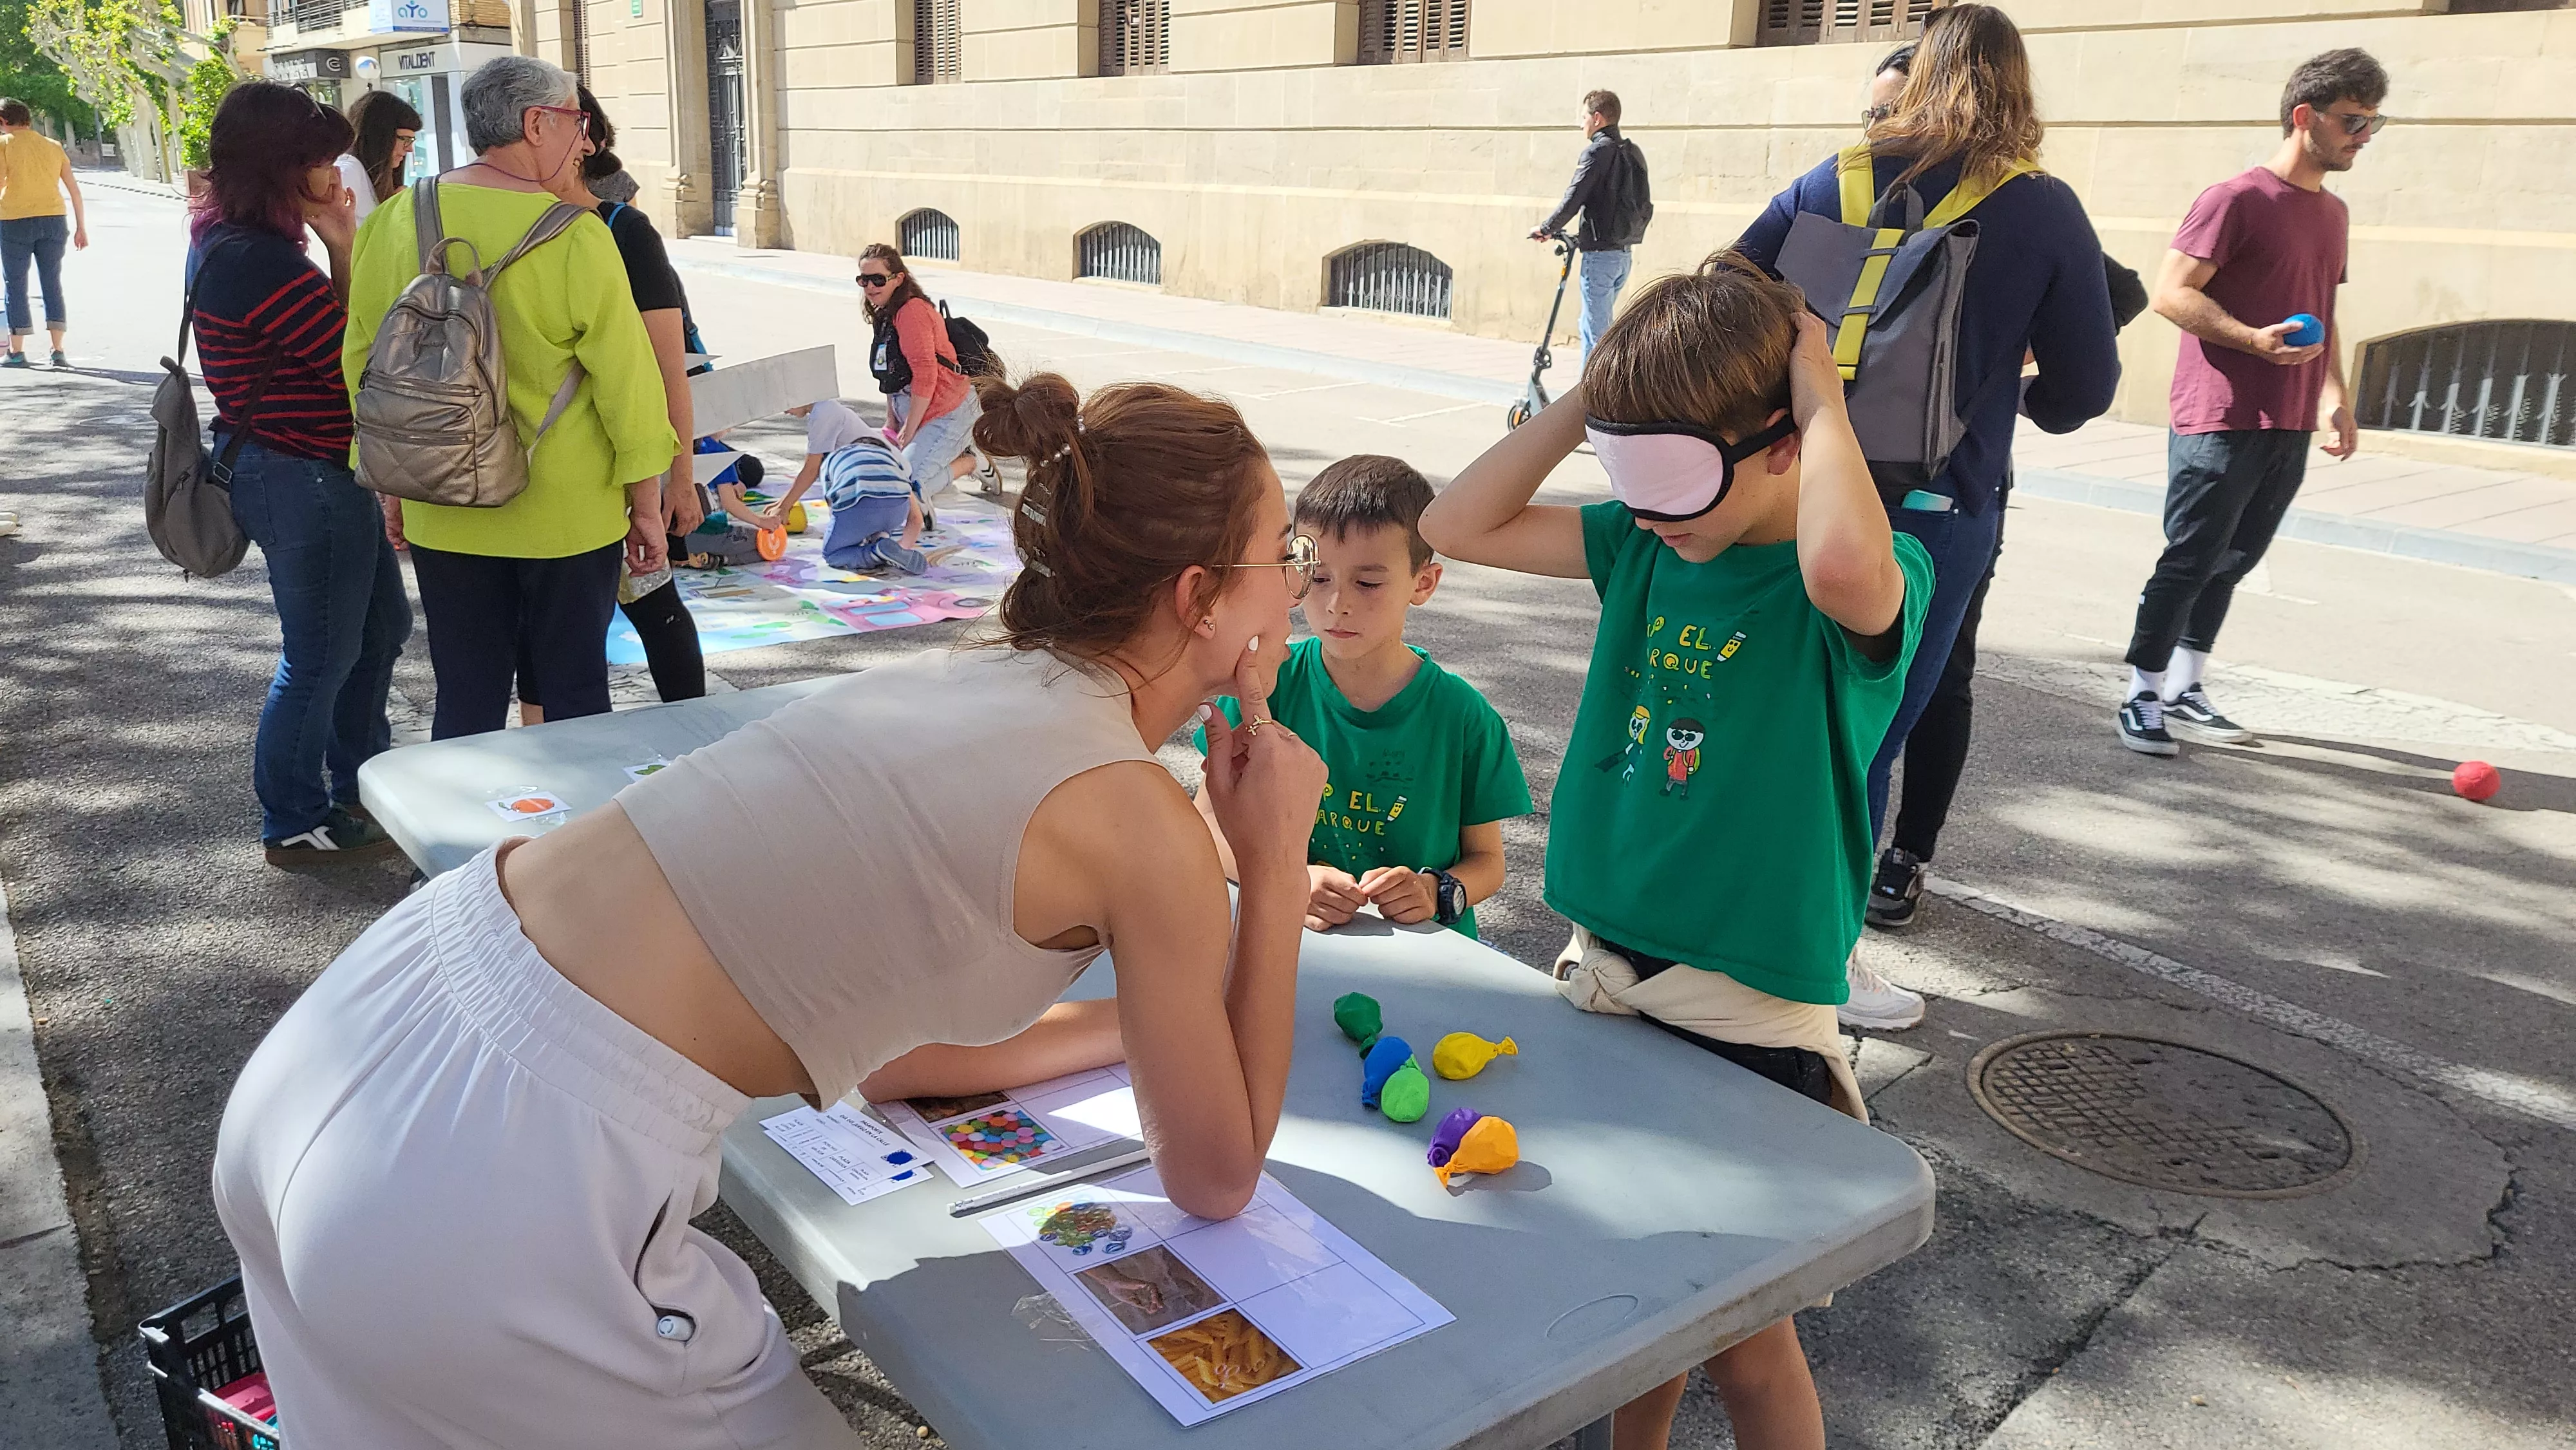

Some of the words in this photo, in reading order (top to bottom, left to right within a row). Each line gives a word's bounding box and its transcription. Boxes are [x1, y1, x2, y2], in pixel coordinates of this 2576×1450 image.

[397, 51, 436, 71] VITALDENT
[1679, 624, 1710, 650] EL
[1649, 648, 1713, 679] RQUE
[1349, 790, 1379, 813] EL
[1315, 809, 1385, 836] ARQUE
